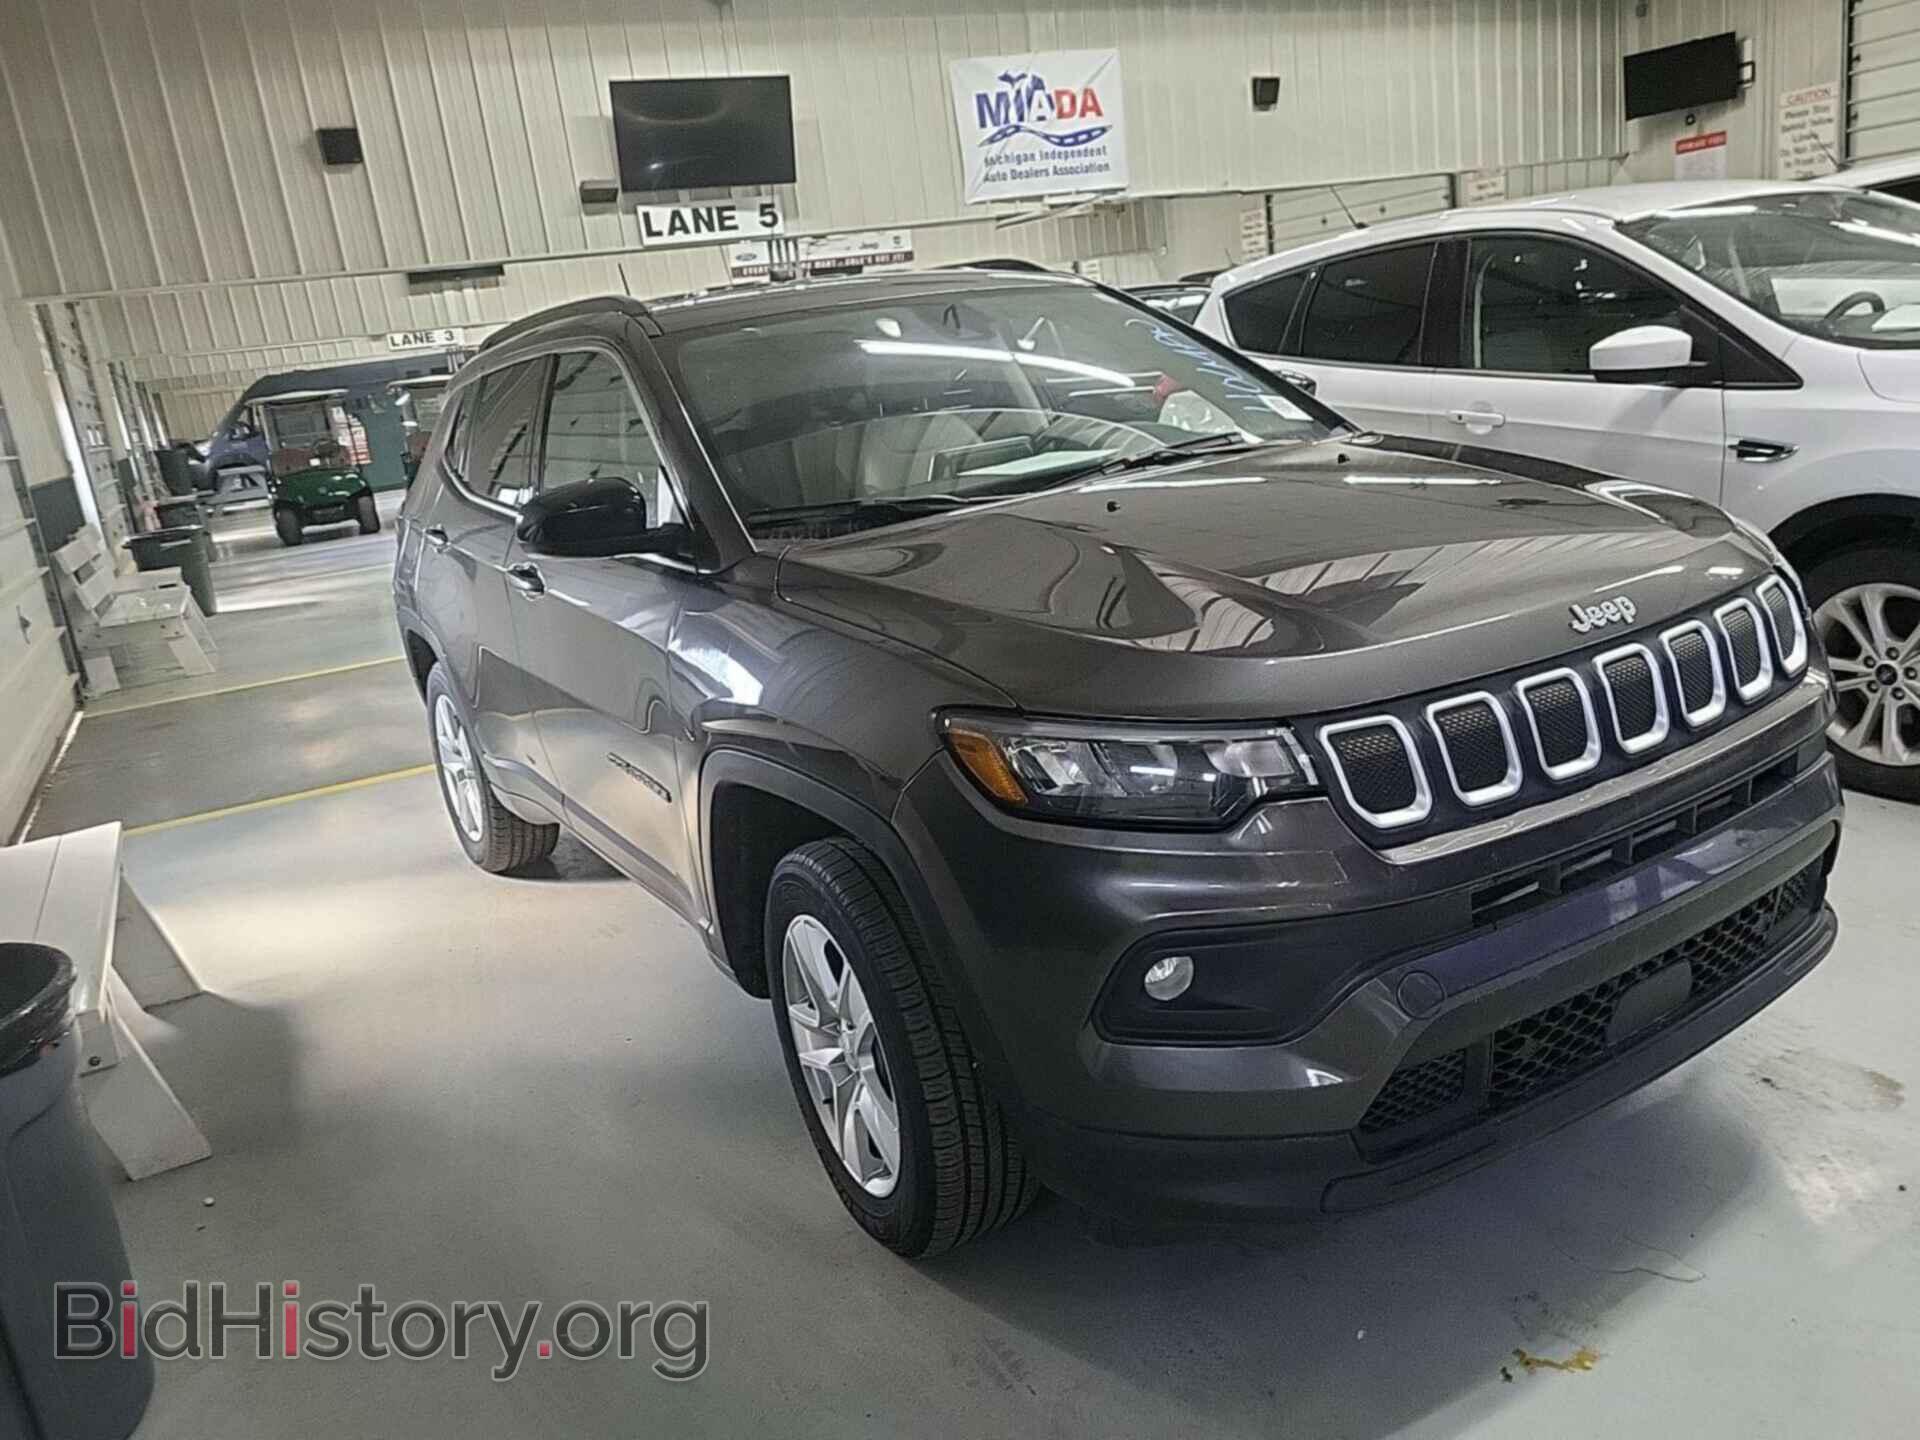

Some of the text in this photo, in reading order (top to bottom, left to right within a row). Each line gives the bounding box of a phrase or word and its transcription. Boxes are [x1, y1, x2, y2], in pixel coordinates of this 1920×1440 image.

[1040, 145, 1107, 160] Independent
[984, 162, 1111, 183] Auto Dealers Association
[642, 203, 779, 238] LANE 5
[389, 330, 455, 347] LANE 3
[1569, 596, 1637, 633] Jeep
